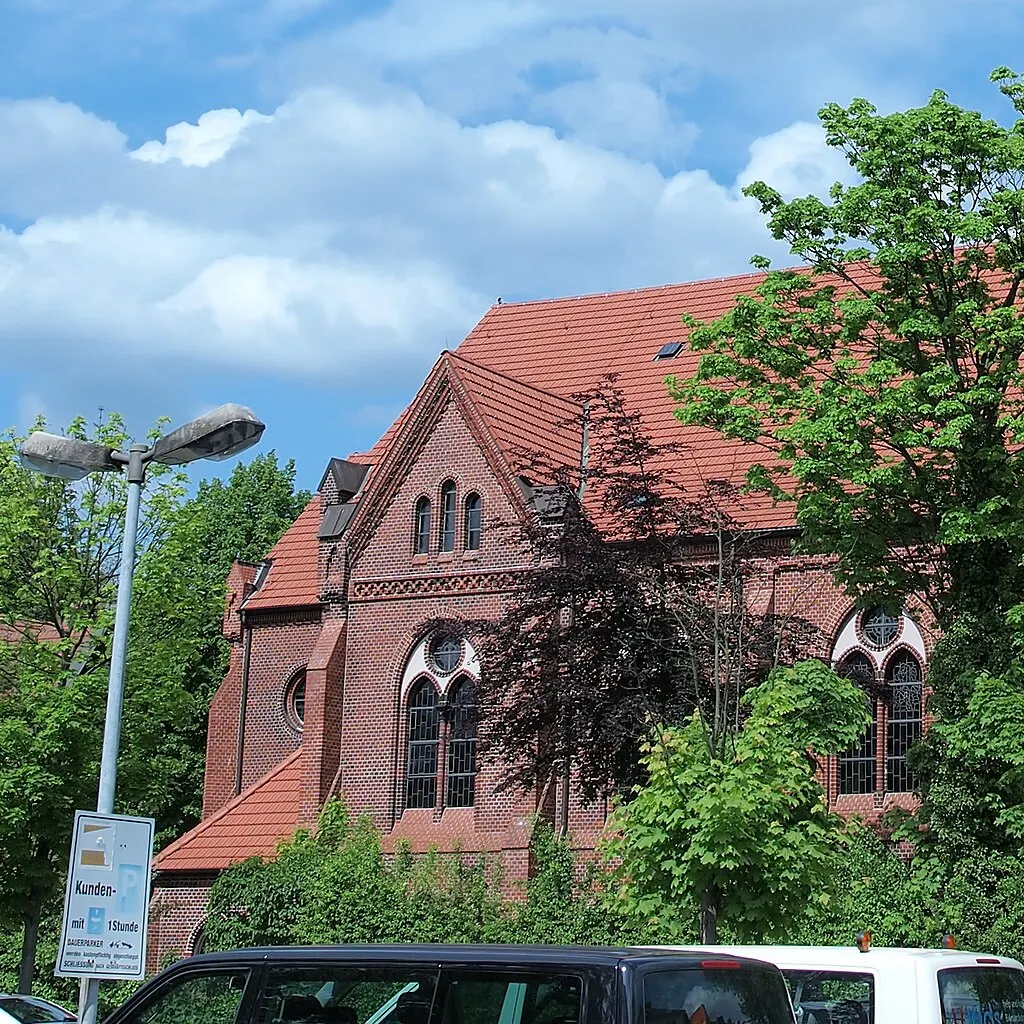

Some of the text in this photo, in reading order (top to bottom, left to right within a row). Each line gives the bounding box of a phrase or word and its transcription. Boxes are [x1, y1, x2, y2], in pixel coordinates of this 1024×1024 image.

[75, 880, 116, 897] Kunden-
[71, 918, 85, 930] mit
[67, 938, 104, 948] DAUERPARKER
